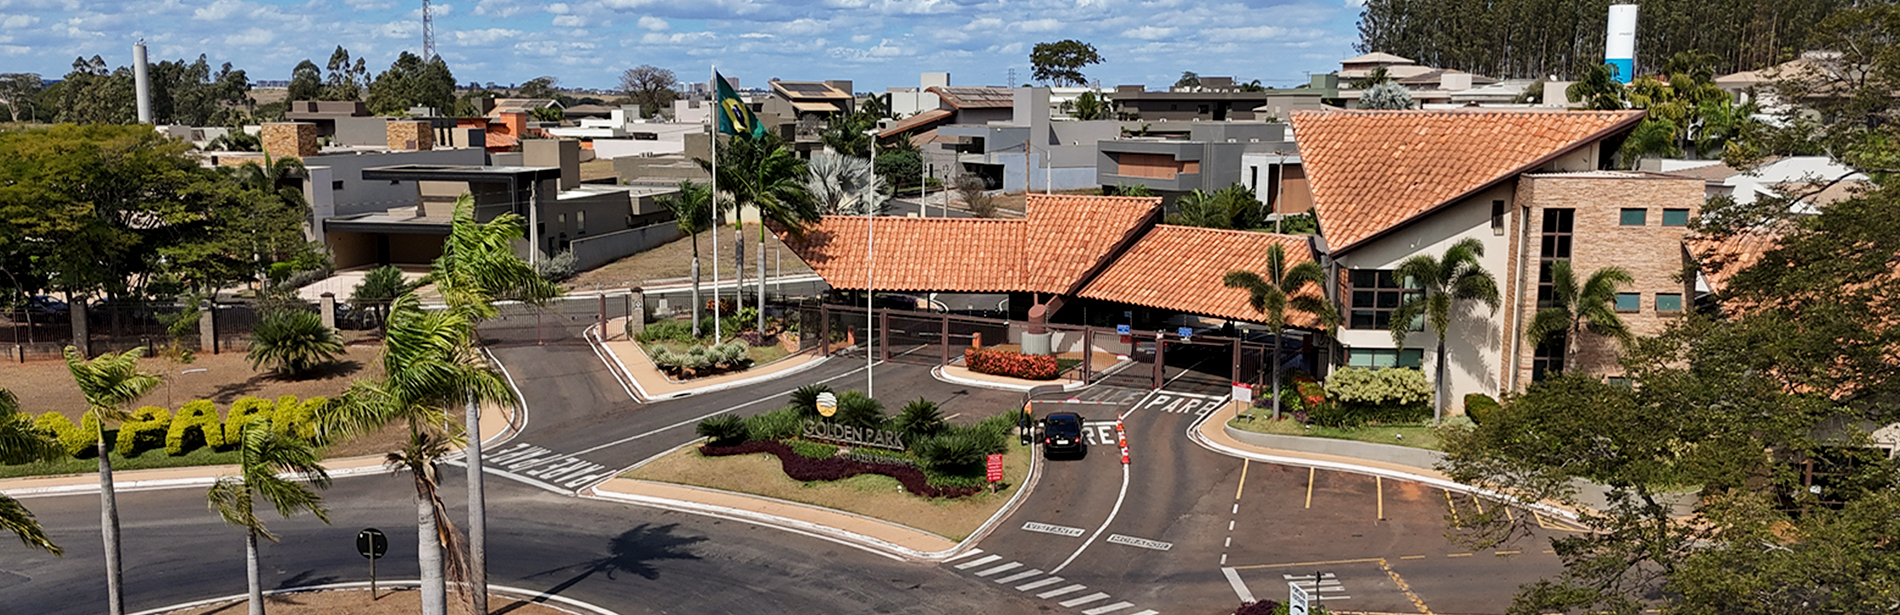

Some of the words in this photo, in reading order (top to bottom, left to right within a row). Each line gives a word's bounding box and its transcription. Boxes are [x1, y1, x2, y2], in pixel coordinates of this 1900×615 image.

[1144, 395, 1218, 416] PARE
[802, 420, 863, 441] GOLDEN
[866, 428, 905, 448] PARK
[526, 457, 617, 488] PARE
